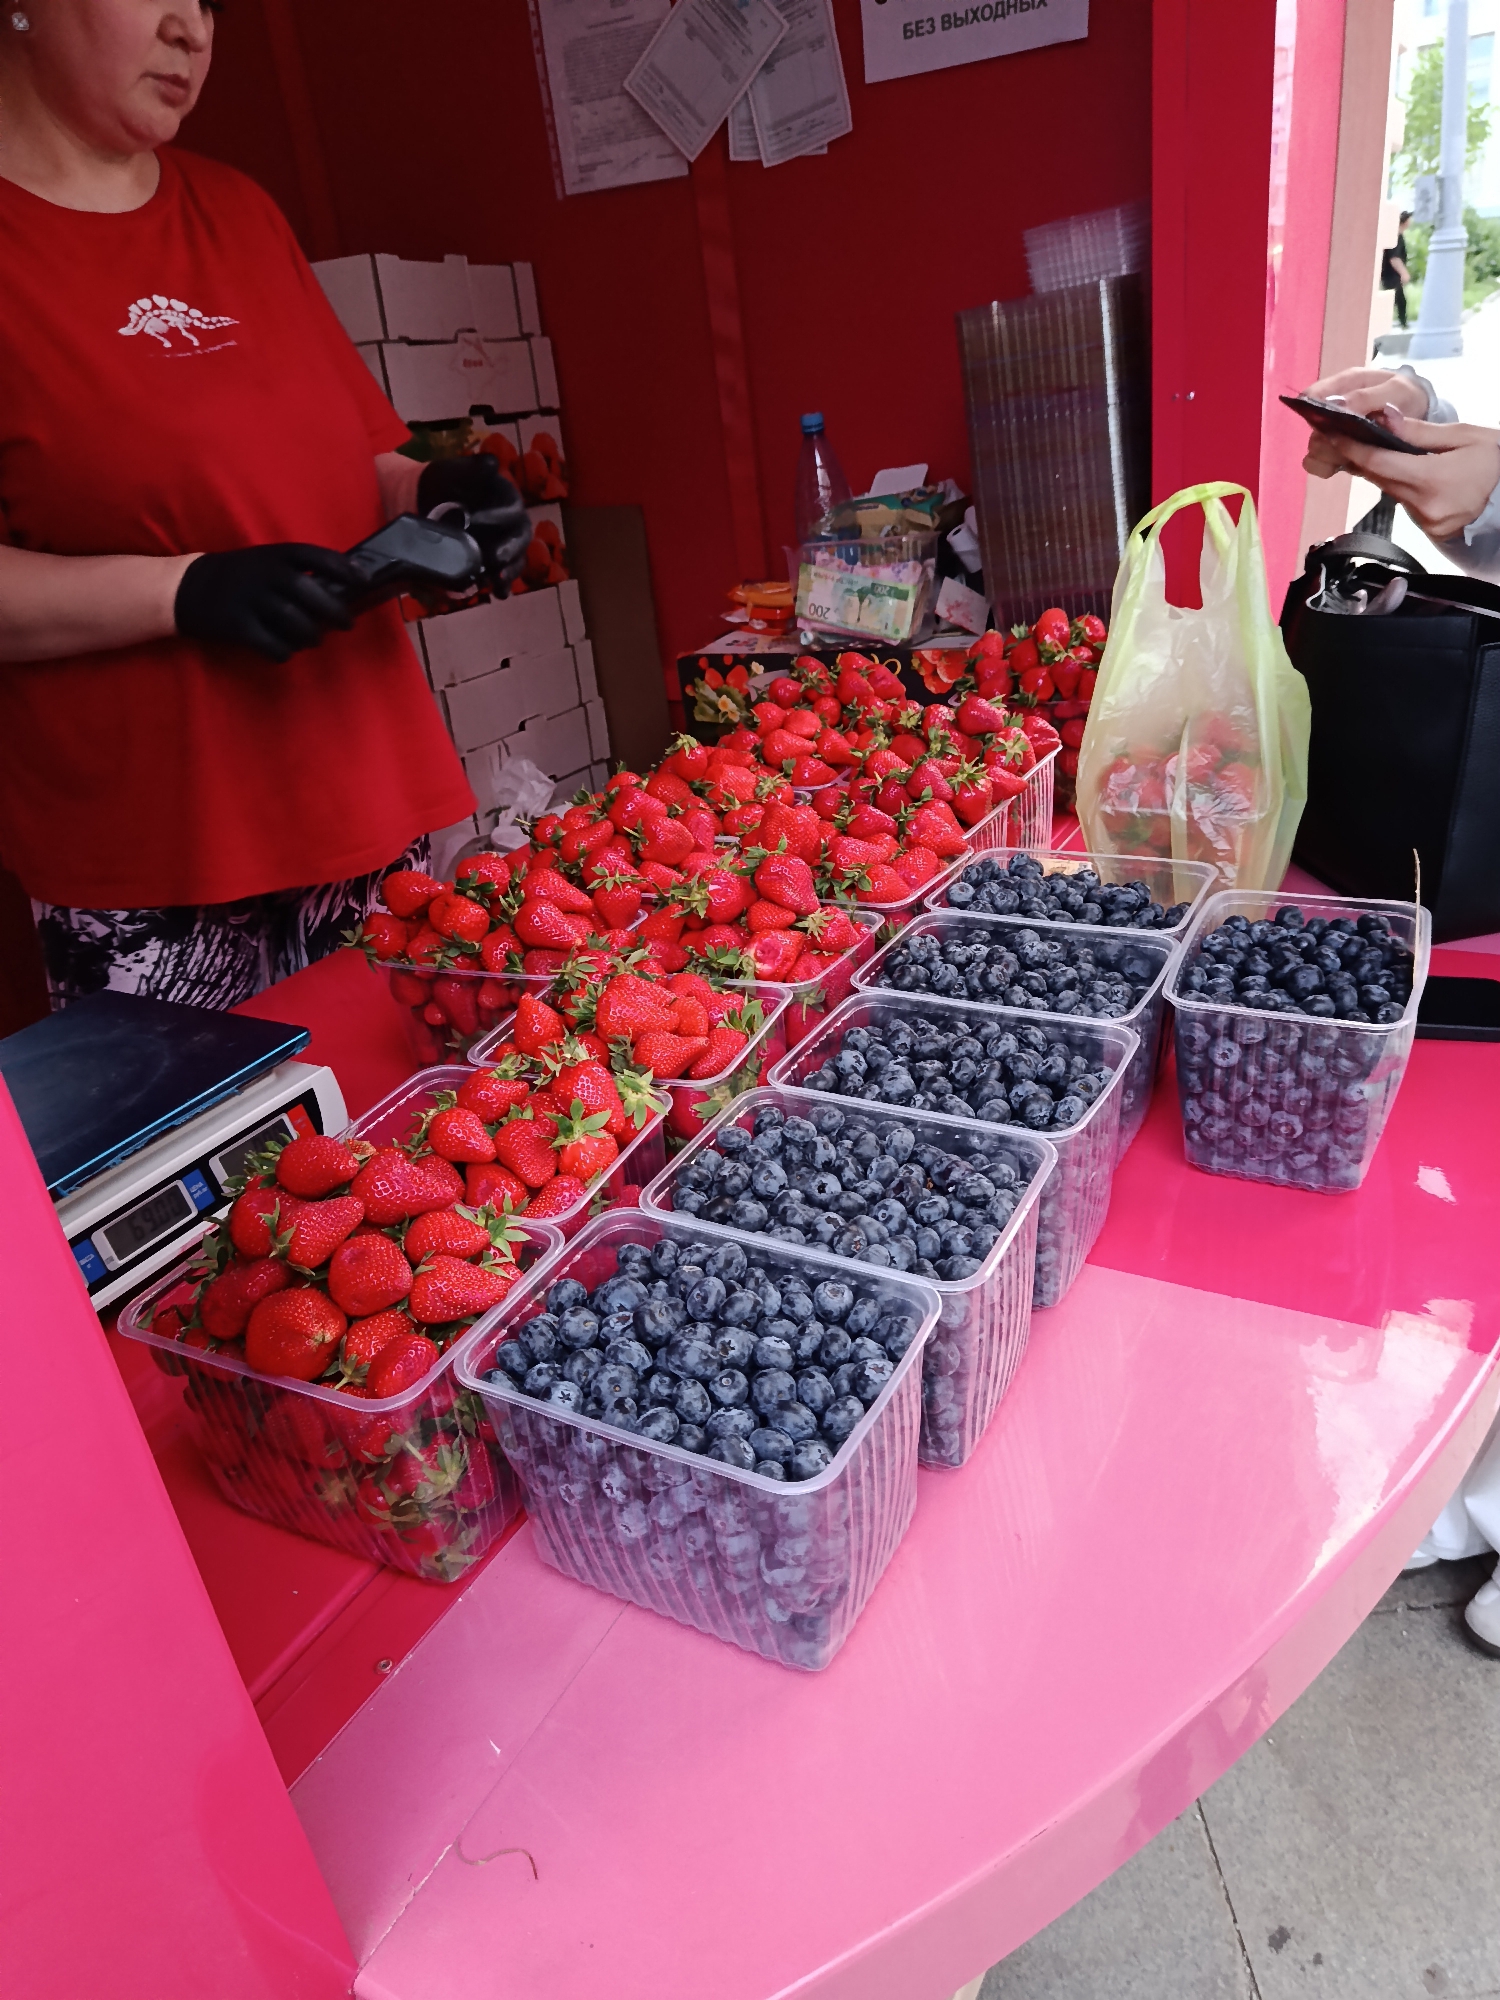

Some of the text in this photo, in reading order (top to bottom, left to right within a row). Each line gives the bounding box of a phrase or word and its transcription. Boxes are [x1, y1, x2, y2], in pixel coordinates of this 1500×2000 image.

[902, 0, 1048, 40] БЕЗ ВЫХОДНЫХ
[808, 602, 831, 620] 200
